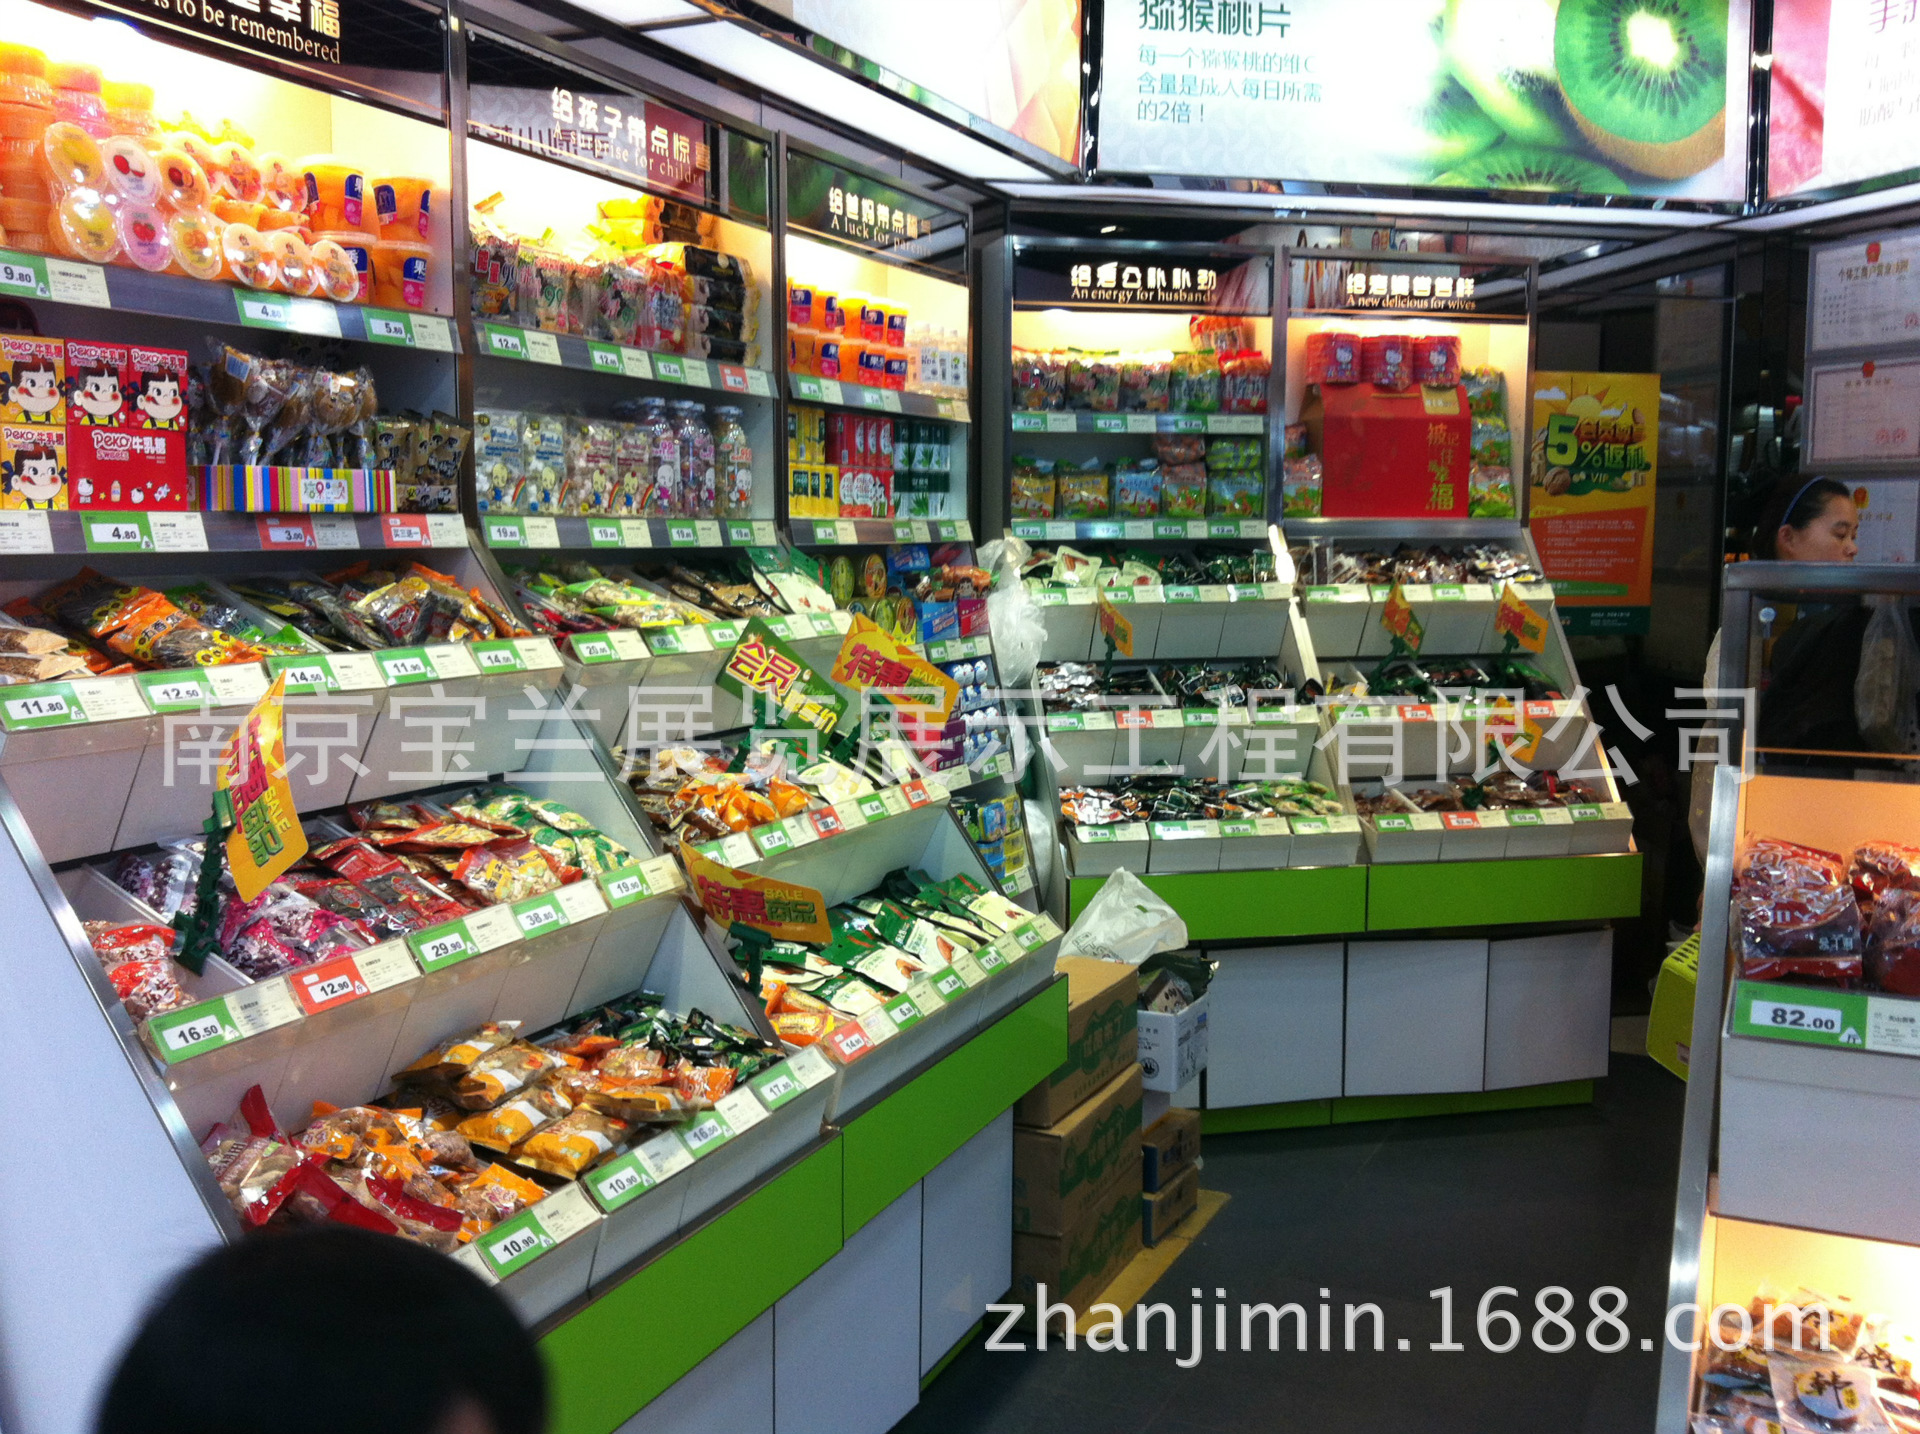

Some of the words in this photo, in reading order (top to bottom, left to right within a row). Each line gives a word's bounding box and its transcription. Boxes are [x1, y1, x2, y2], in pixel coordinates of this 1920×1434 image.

[1138, 0, 1291, 39] 猕猴桃片
[176, 0, 197, 18] to
[202, 1, 225, 28] be
[230, 13, 341, 65] remembered
[1136, 71, 1323, 104] 含量是成人每日所需
[551, 86, 711, 172] 给孩子带点惊喜
[552, 120, 563, 140] A
[570, 129, 629, 163] surprise
[635, 146, 654, 171] for
[831, 213, 840, 231] A
[844, 215, 870, 240] luck
[874, 226, 890, 246] for
[3, 265, 32, 284] 9.80
[1071, 286, 1089, 300] An
[1091, 288, 1134, 305] energy
[1136, 286, 1155, 301] for
[1158, 288, 1218, 304] husbands
[1345, 294, 1356, 307] A
[1358, 296, 1381, 308] new
[1382, 293, 1429, 310] delicious
[1430, 295, 1446, 310] for
[1448, 298, 1477, 311] wives
[132, 434, 167, 455] 牛乳糖
[111, 526, 138, 541] 4.80
[290, 670, 323, 684] 14.50
[727, 641, 801, 705] 会员
[843, 642, 914, 703] 特惠
[161, 687, 201, 702] 12.50
[20, 699, 64, 716] 11.80
[265, 785, 292, 835] SALE
[240, 795, 285, 868] 商品
[697, 874, 783, 928] 特惠
[765, 898, 818, 924] 商品
[430, 939, 462, 958] 29.90
[319, 980, 350, 997] 12.90
[1770, 1006, 1836, 1032] 82.00
[178, 1024, 219, 1045] 16.50
[607, 1174, 638, 1195] 10.90
[502, 1235, 535, 1258] 10.90
